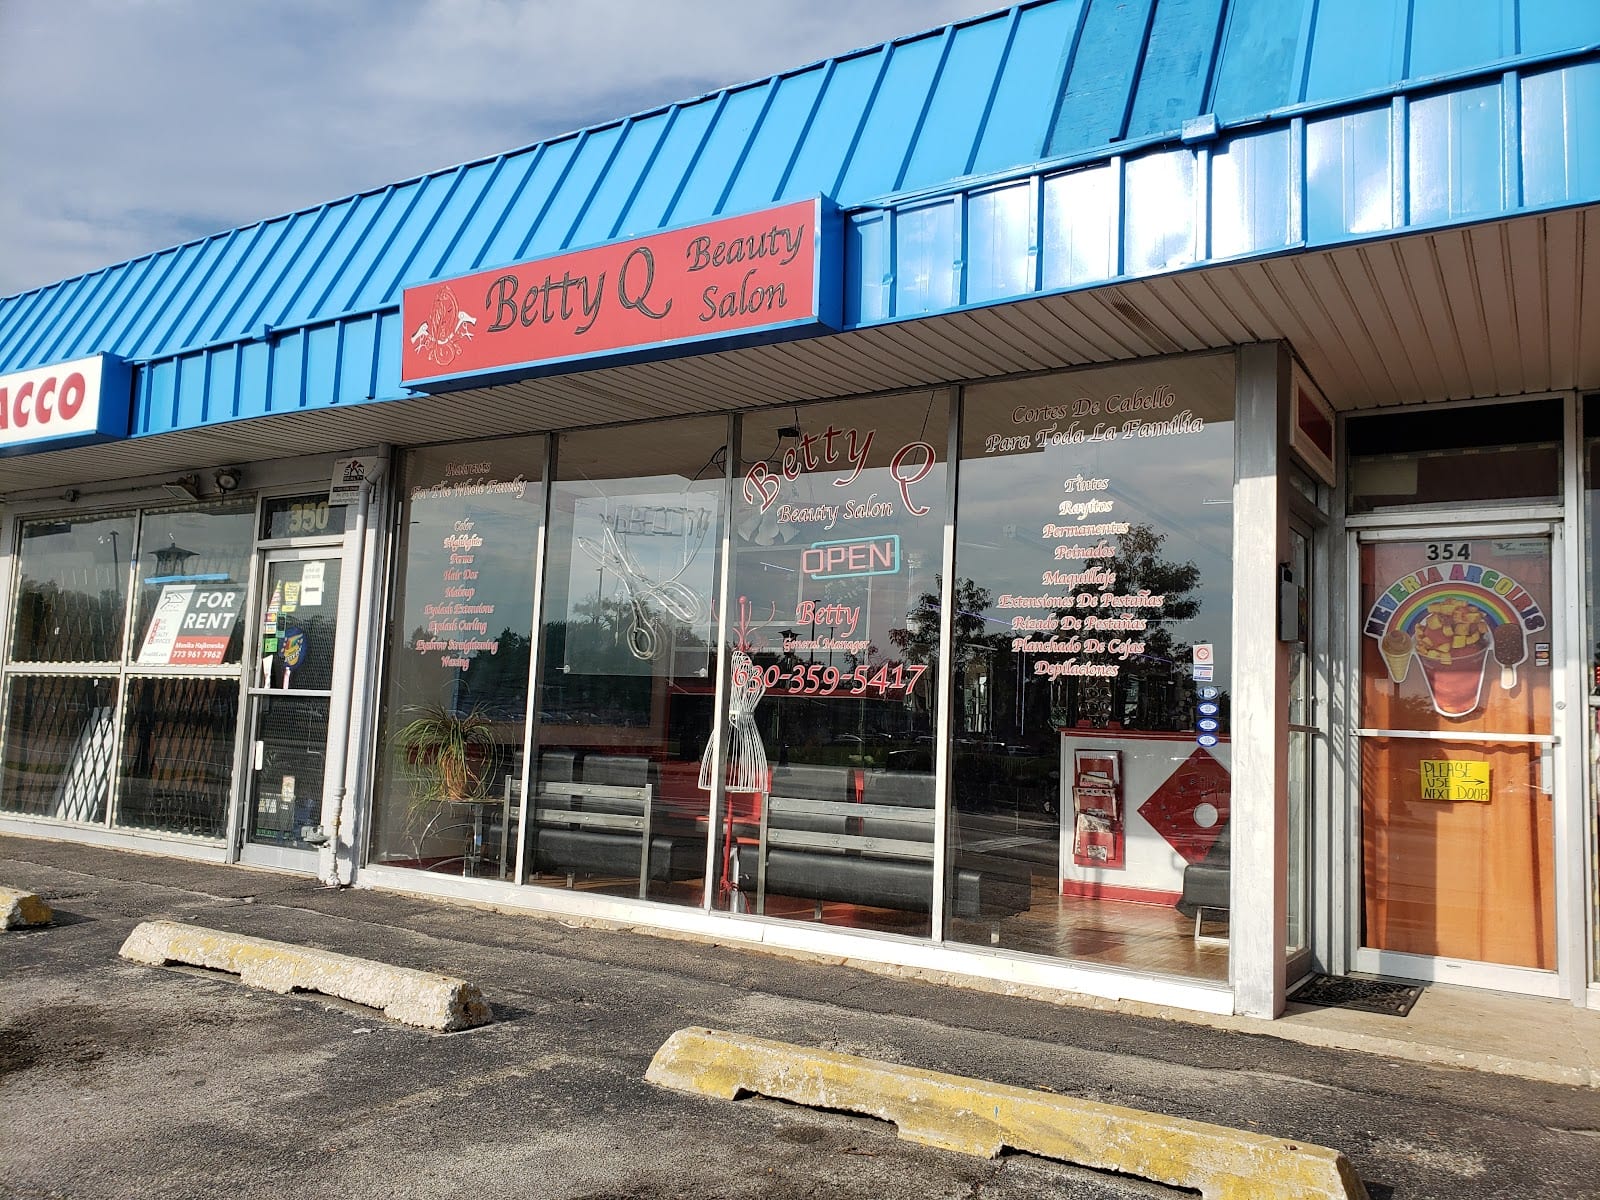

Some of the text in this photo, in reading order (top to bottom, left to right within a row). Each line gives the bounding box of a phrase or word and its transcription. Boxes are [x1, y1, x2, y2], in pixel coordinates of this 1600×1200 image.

[687, 223, 805, 272] Beauty
[486, 246, 672, 335] Betty Q
[699, 268, 787, 322] Salon
[1012, 384, 1176, 424] Cortes De Cabello
[985, 432, 1031, 453] Para
[1035, 421, 1085, 448] Toda
[1087, 422, 1117, 443] La
[743, 424, 936, 516] Betty Q
[411, 474, 528, 500] For The Whole Family
[1064, 474, 1109, 493] Tintes
[288, 502, 330, 532] 350
[777, 493, 894, 530] Beauty Salon
[1058, 498, 1114, 520] Rayitos
[453, 518, 476, 531] Color
[1042, 521, 1130, 538] Permanentes
[802, 542, 891, 574] OPEN
[1054, 540, 1116, 560] Peinados
[1427, 543, 1471, 561] 354
[443, 567, 463, 581] Hair
[1042, 567, 1116, 591] Maquillaje
[196, 591, 236, 609] FOR
[996, 589, 1165, 610] Extensiones De Pestañas
[1366, 564, 1546, 636] NEVERIA ARCOIRIS
[183, 612, 235, 630] RENT
[458, 617, 487, 635] Curling
[796, 600, 860, 637] Betty
[1011, 613, 1148, 631] Rizado De Pestañas
[171, 650, 187, 658] 773
[187, 650, 201, 658] 961
[783, 635, 870, 655] General Manager
[1011, 637, 1145, 662] Planchado De Cejas
[733, 662, 929, 696] 630-359-5417
[1034, 660, 1120, 681] Depilaciones
[1423, 761, 1473, 778] PLEASE
[1424, 785, 1489, 800] NEXT DOOR
[1426, 777, 1452, 788] USE
